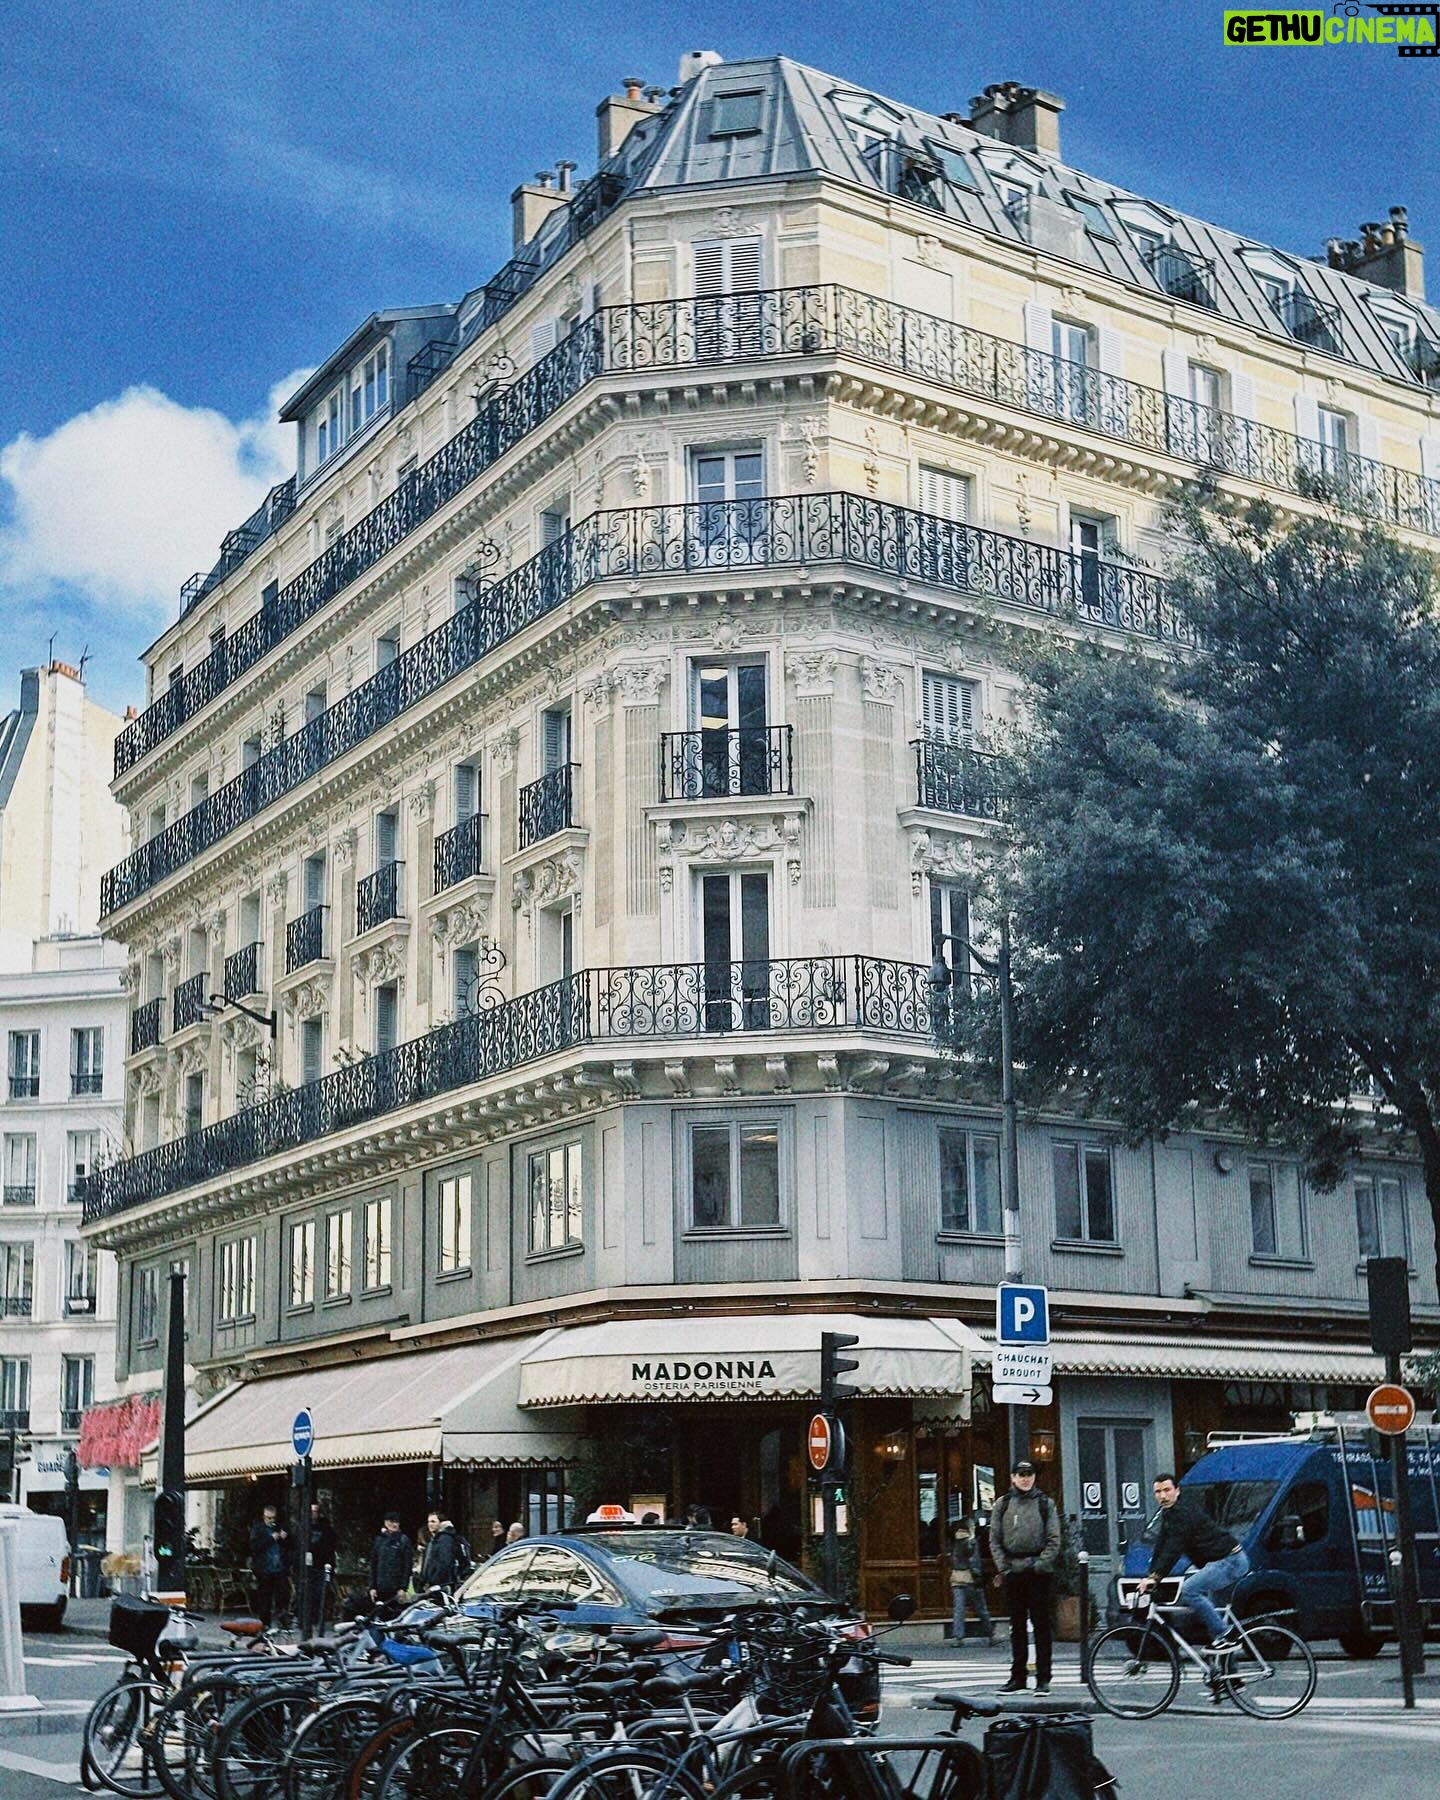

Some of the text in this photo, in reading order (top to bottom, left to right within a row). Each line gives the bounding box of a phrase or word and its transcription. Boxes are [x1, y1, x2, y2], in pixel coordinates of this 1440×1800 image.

[1014, 1296, 1035, 1332] P
[997, 1353, 1049, 1365] CHAUCHAT
[632, 1360, 776, 1381] MADONNA
[1002, 1368, 1042, 1378] DROUOT
[644, 1380, 762, 1390] OSTERIA PARISIENNE
